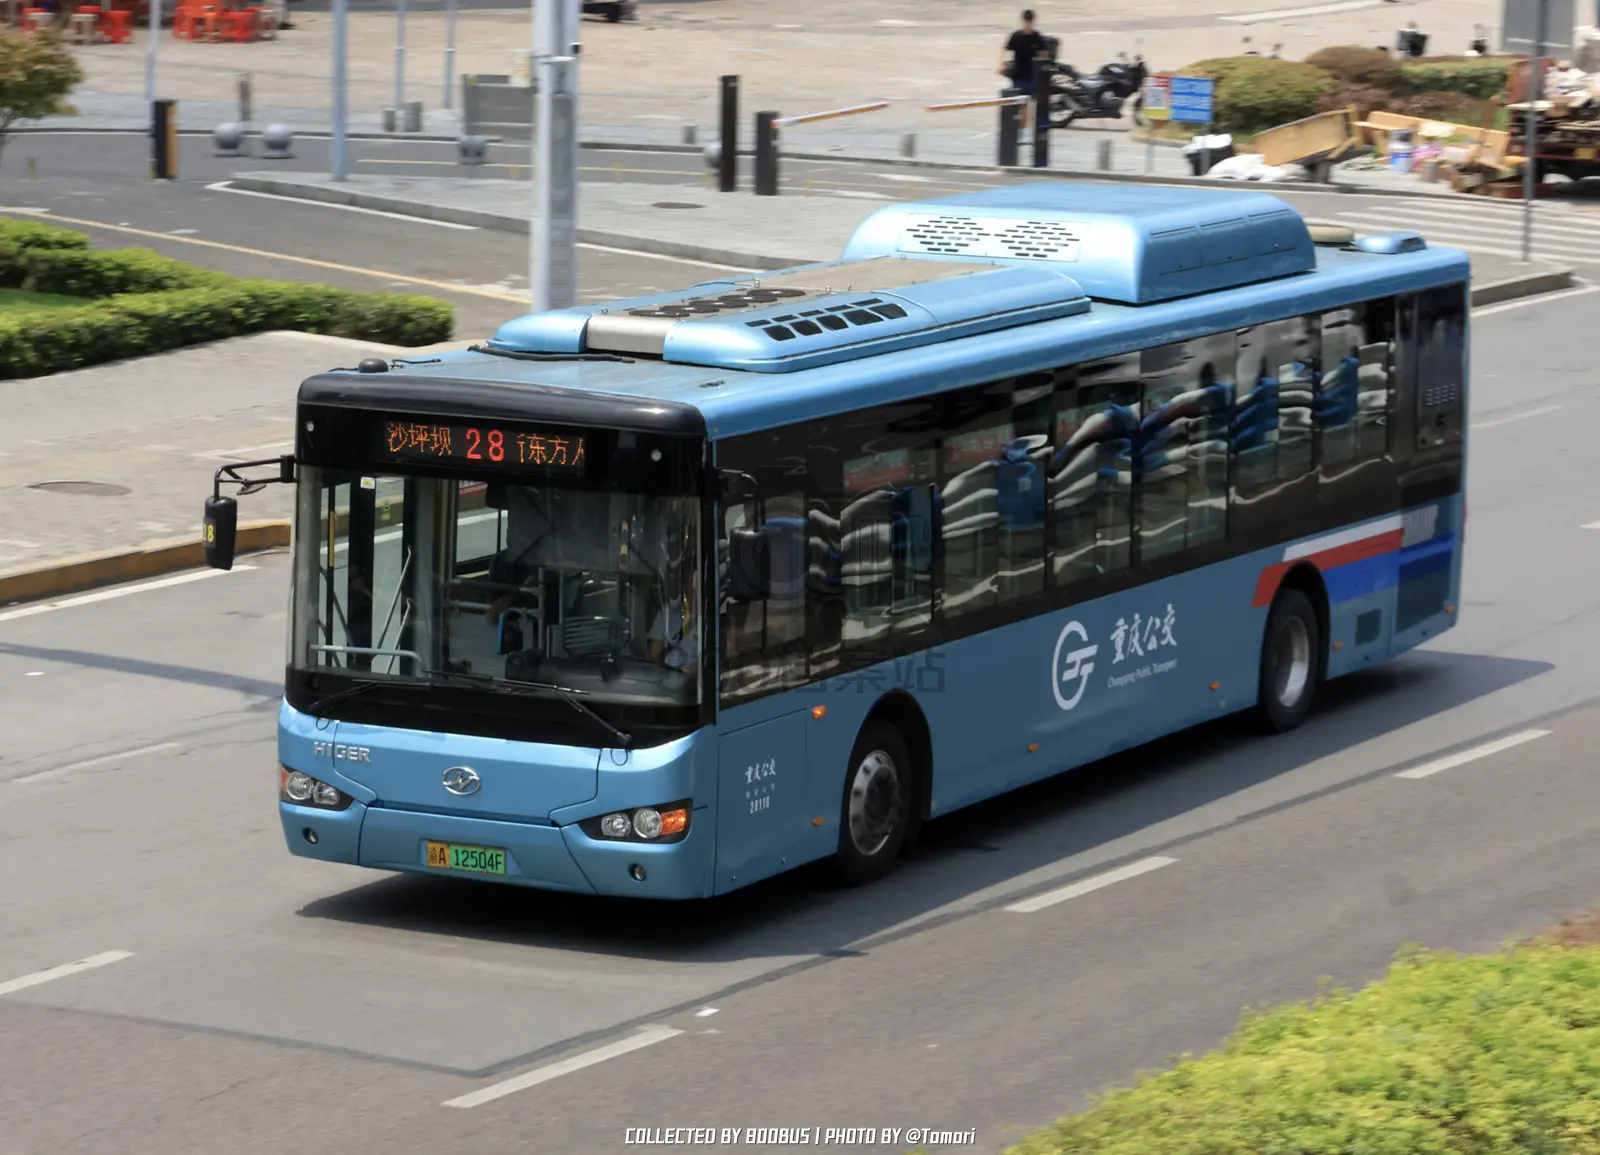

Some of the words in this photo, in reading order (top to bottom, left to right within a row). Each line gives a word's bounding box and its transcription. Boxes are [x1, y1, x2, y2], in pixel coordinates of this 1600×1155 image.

[387, 422, 452, 457] 沙坪坝
[466, 427, 505, 461] 28
[313, 741, 372, 763] HIGER
[454, 848, 503, 872] 12504F
